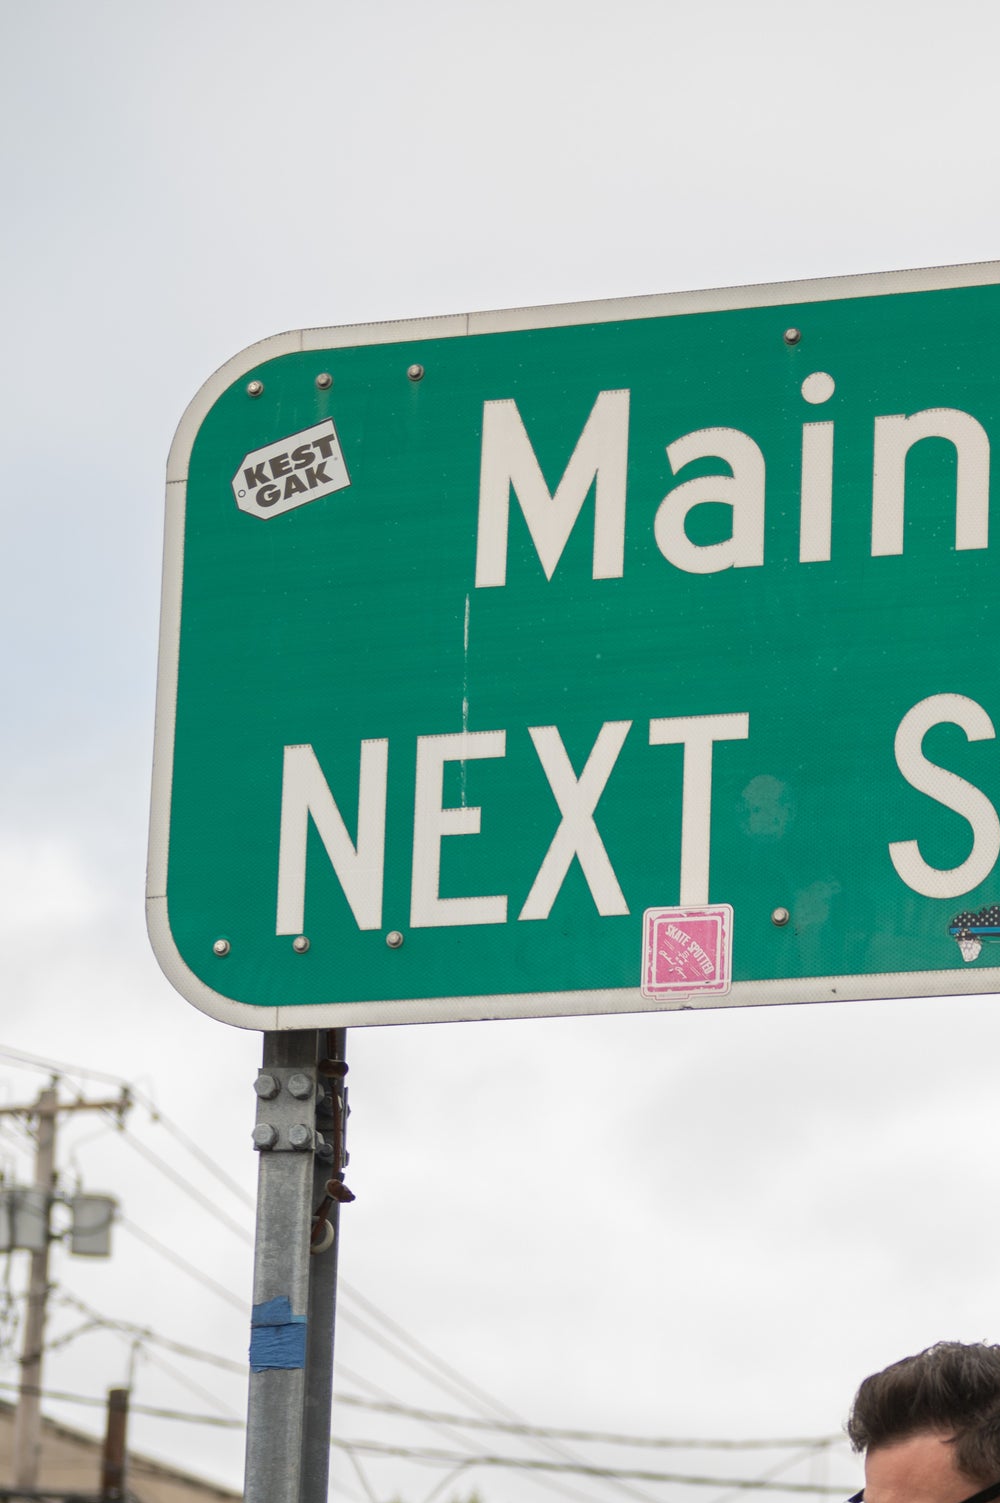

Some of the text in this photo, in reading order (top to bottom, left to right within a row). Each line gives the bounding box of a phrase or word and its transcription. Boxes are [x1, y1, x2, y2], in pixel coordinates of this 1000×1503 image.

[243, 433, 335, 490] KEST
[255, 461, 334, 508] GAK
[475, 371, 991, 589] Main
[275, 711, 750, 936] NEXT
[664, 924, 692, 947] SKATE
[687, 941, 715, 975] SPOTTED
